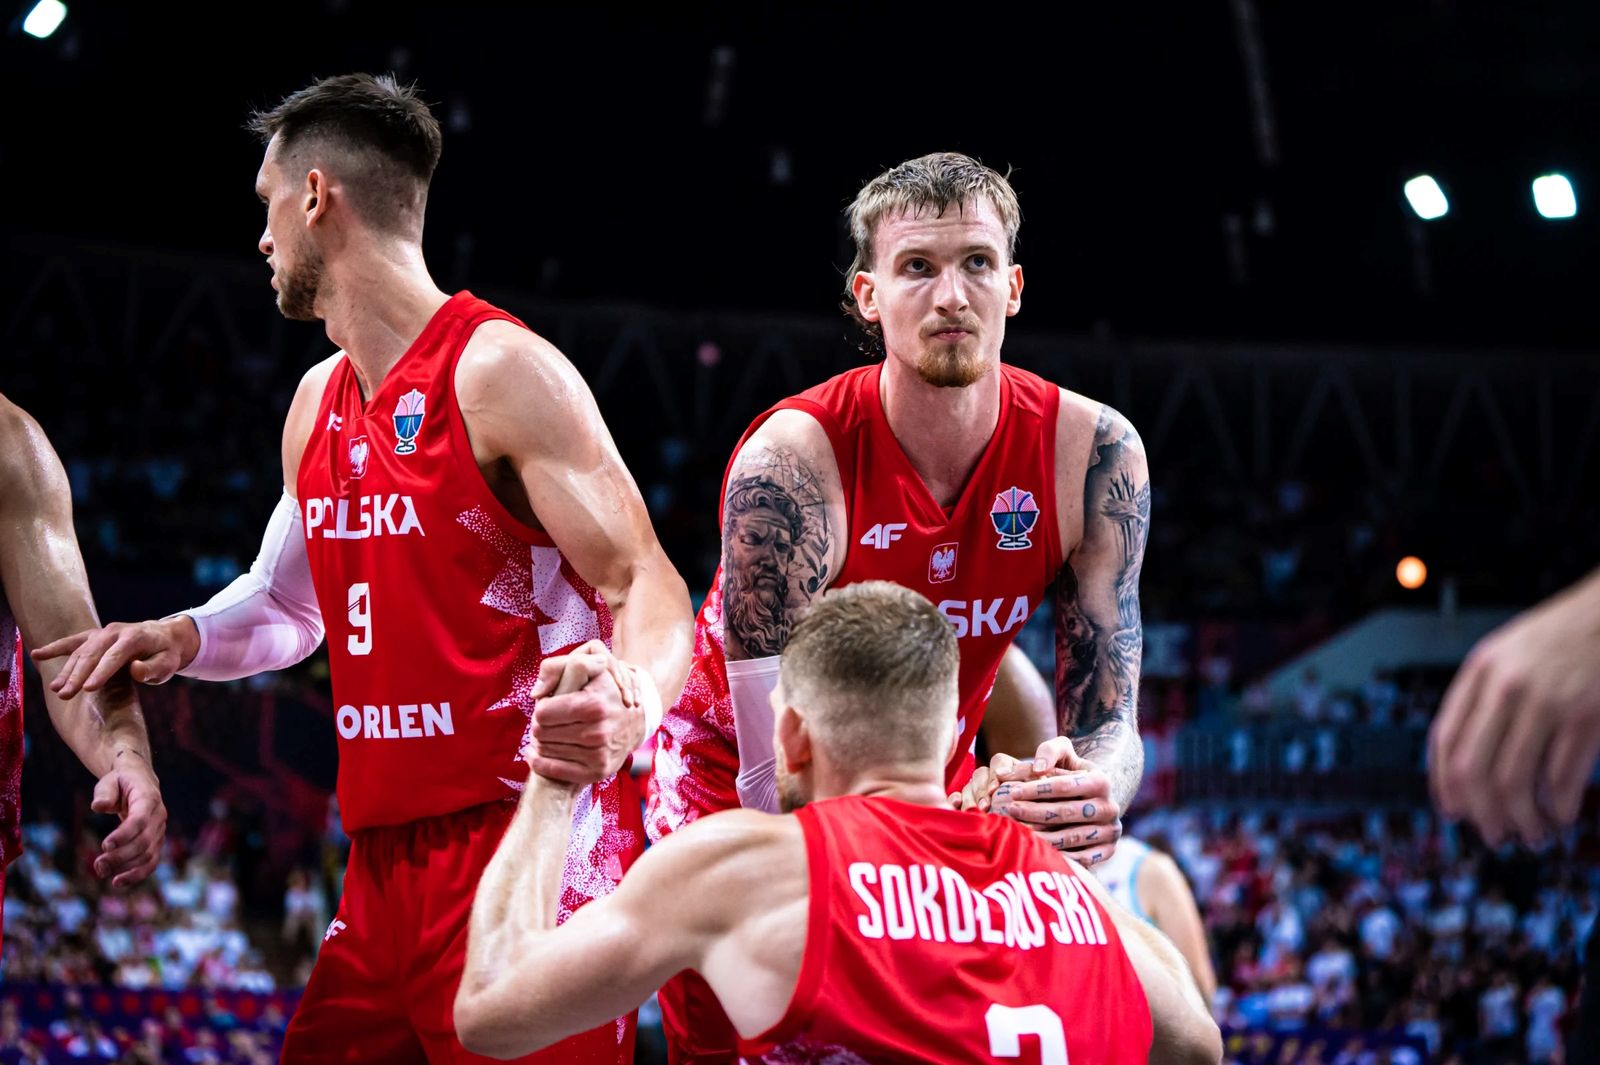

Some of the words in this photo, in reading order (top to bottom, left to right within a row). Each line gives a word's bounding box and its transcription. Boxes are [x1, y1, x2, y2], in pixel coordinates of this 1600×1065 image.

[305, 493, 426, 540] POLSKA
[860, 523, 908, 550] 4F
[347, 582, 373, 656] 9
[937, 595, 1030, 639] SKA
[336, 702, 455, 740] ORLEN
